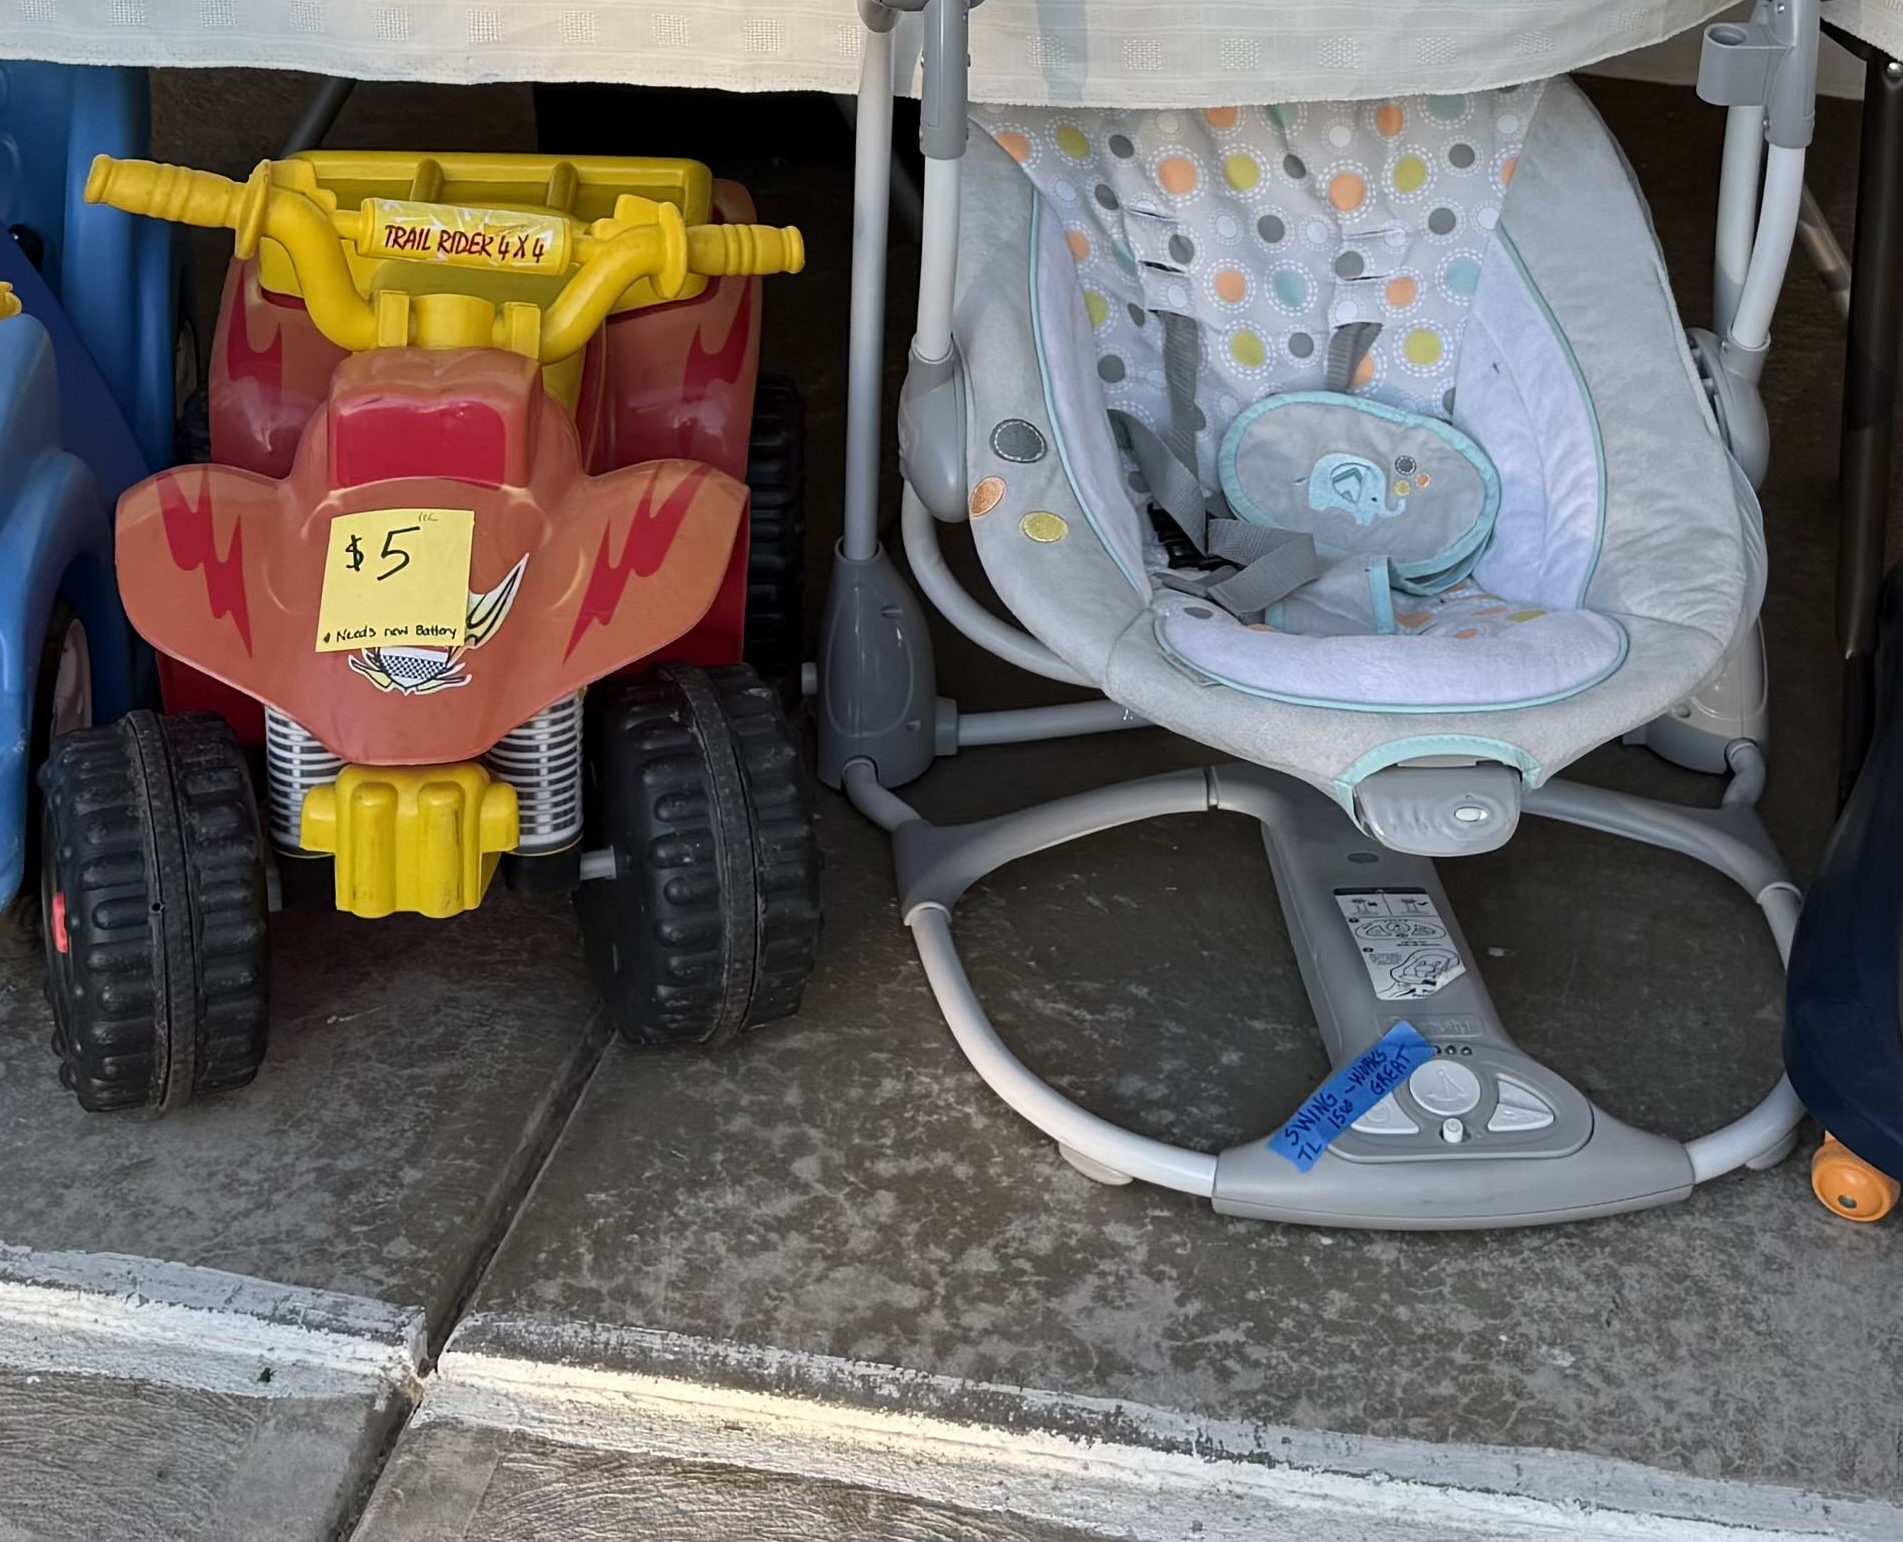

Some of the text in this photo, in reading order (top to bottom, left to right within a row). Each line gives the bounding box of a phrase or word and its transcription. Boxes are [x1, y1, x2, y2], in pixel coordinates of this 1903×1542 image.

[385, 224, 432, 251] TRAIL
[437, 229, 494, 258] RIDER
[345, 525, 421, 581] $5
[336, 623, 457, 642] Needs new Battery
[1285, 1091, 1338, 1146] SWING
[1347, 1048, 1388, 1087] WORKS
[1297, 1141, 1323, 1161] TL
[1370, 1043, 1410, 1096] GREAT
